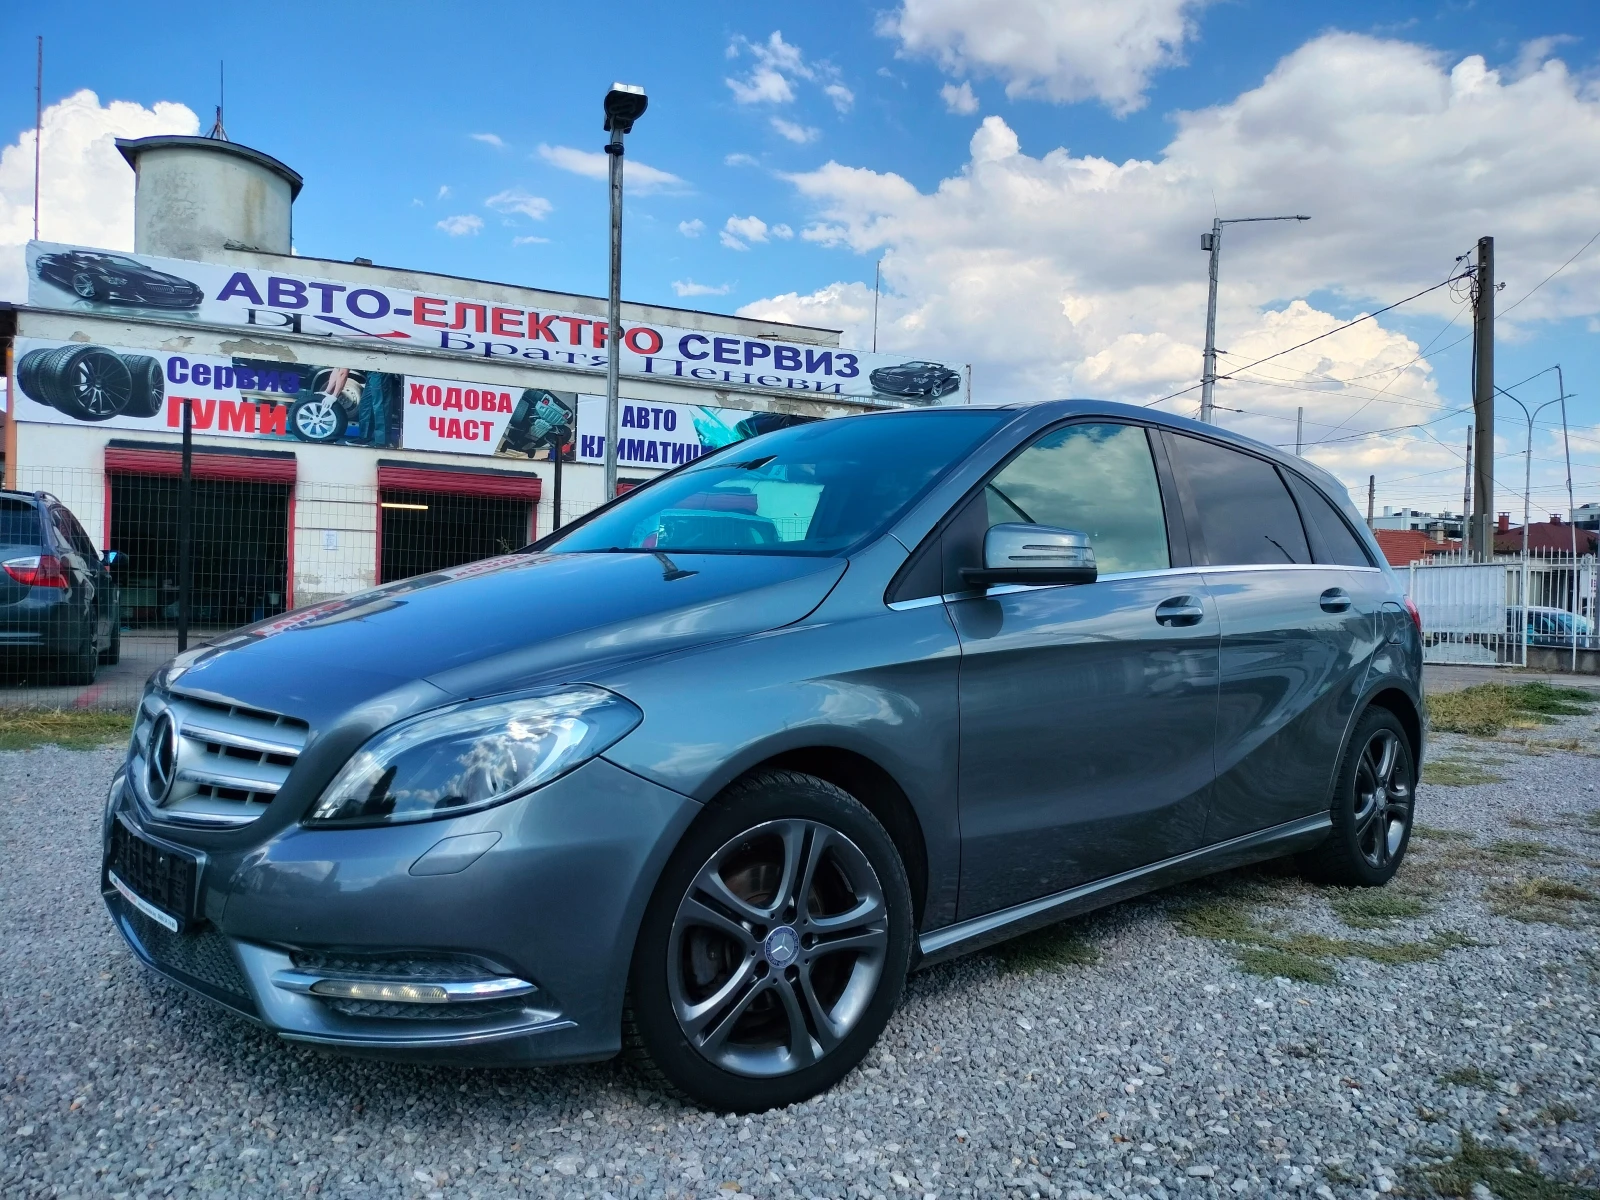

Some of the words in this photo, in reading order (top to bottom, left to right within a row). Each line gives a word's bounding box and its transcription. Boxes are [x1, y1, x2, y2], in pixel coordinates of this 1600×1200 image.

[216, 272, 663, 355] АВТО-ЕЛЕКТРО
[678, 334, 860, 378] СЕРВИЗ
[167, 356, 300, 393] Сервиз
[435, 330, 610, 367] Братя
[639, 355, 844, 394] Пеневи
[167, 395, 287, 436] ГУМИ
[409, 383, 513, 413] ХОДОВА
[429, 416, 495, 442] ЧАСТ
[621, 405, 677, 431] АВТО
